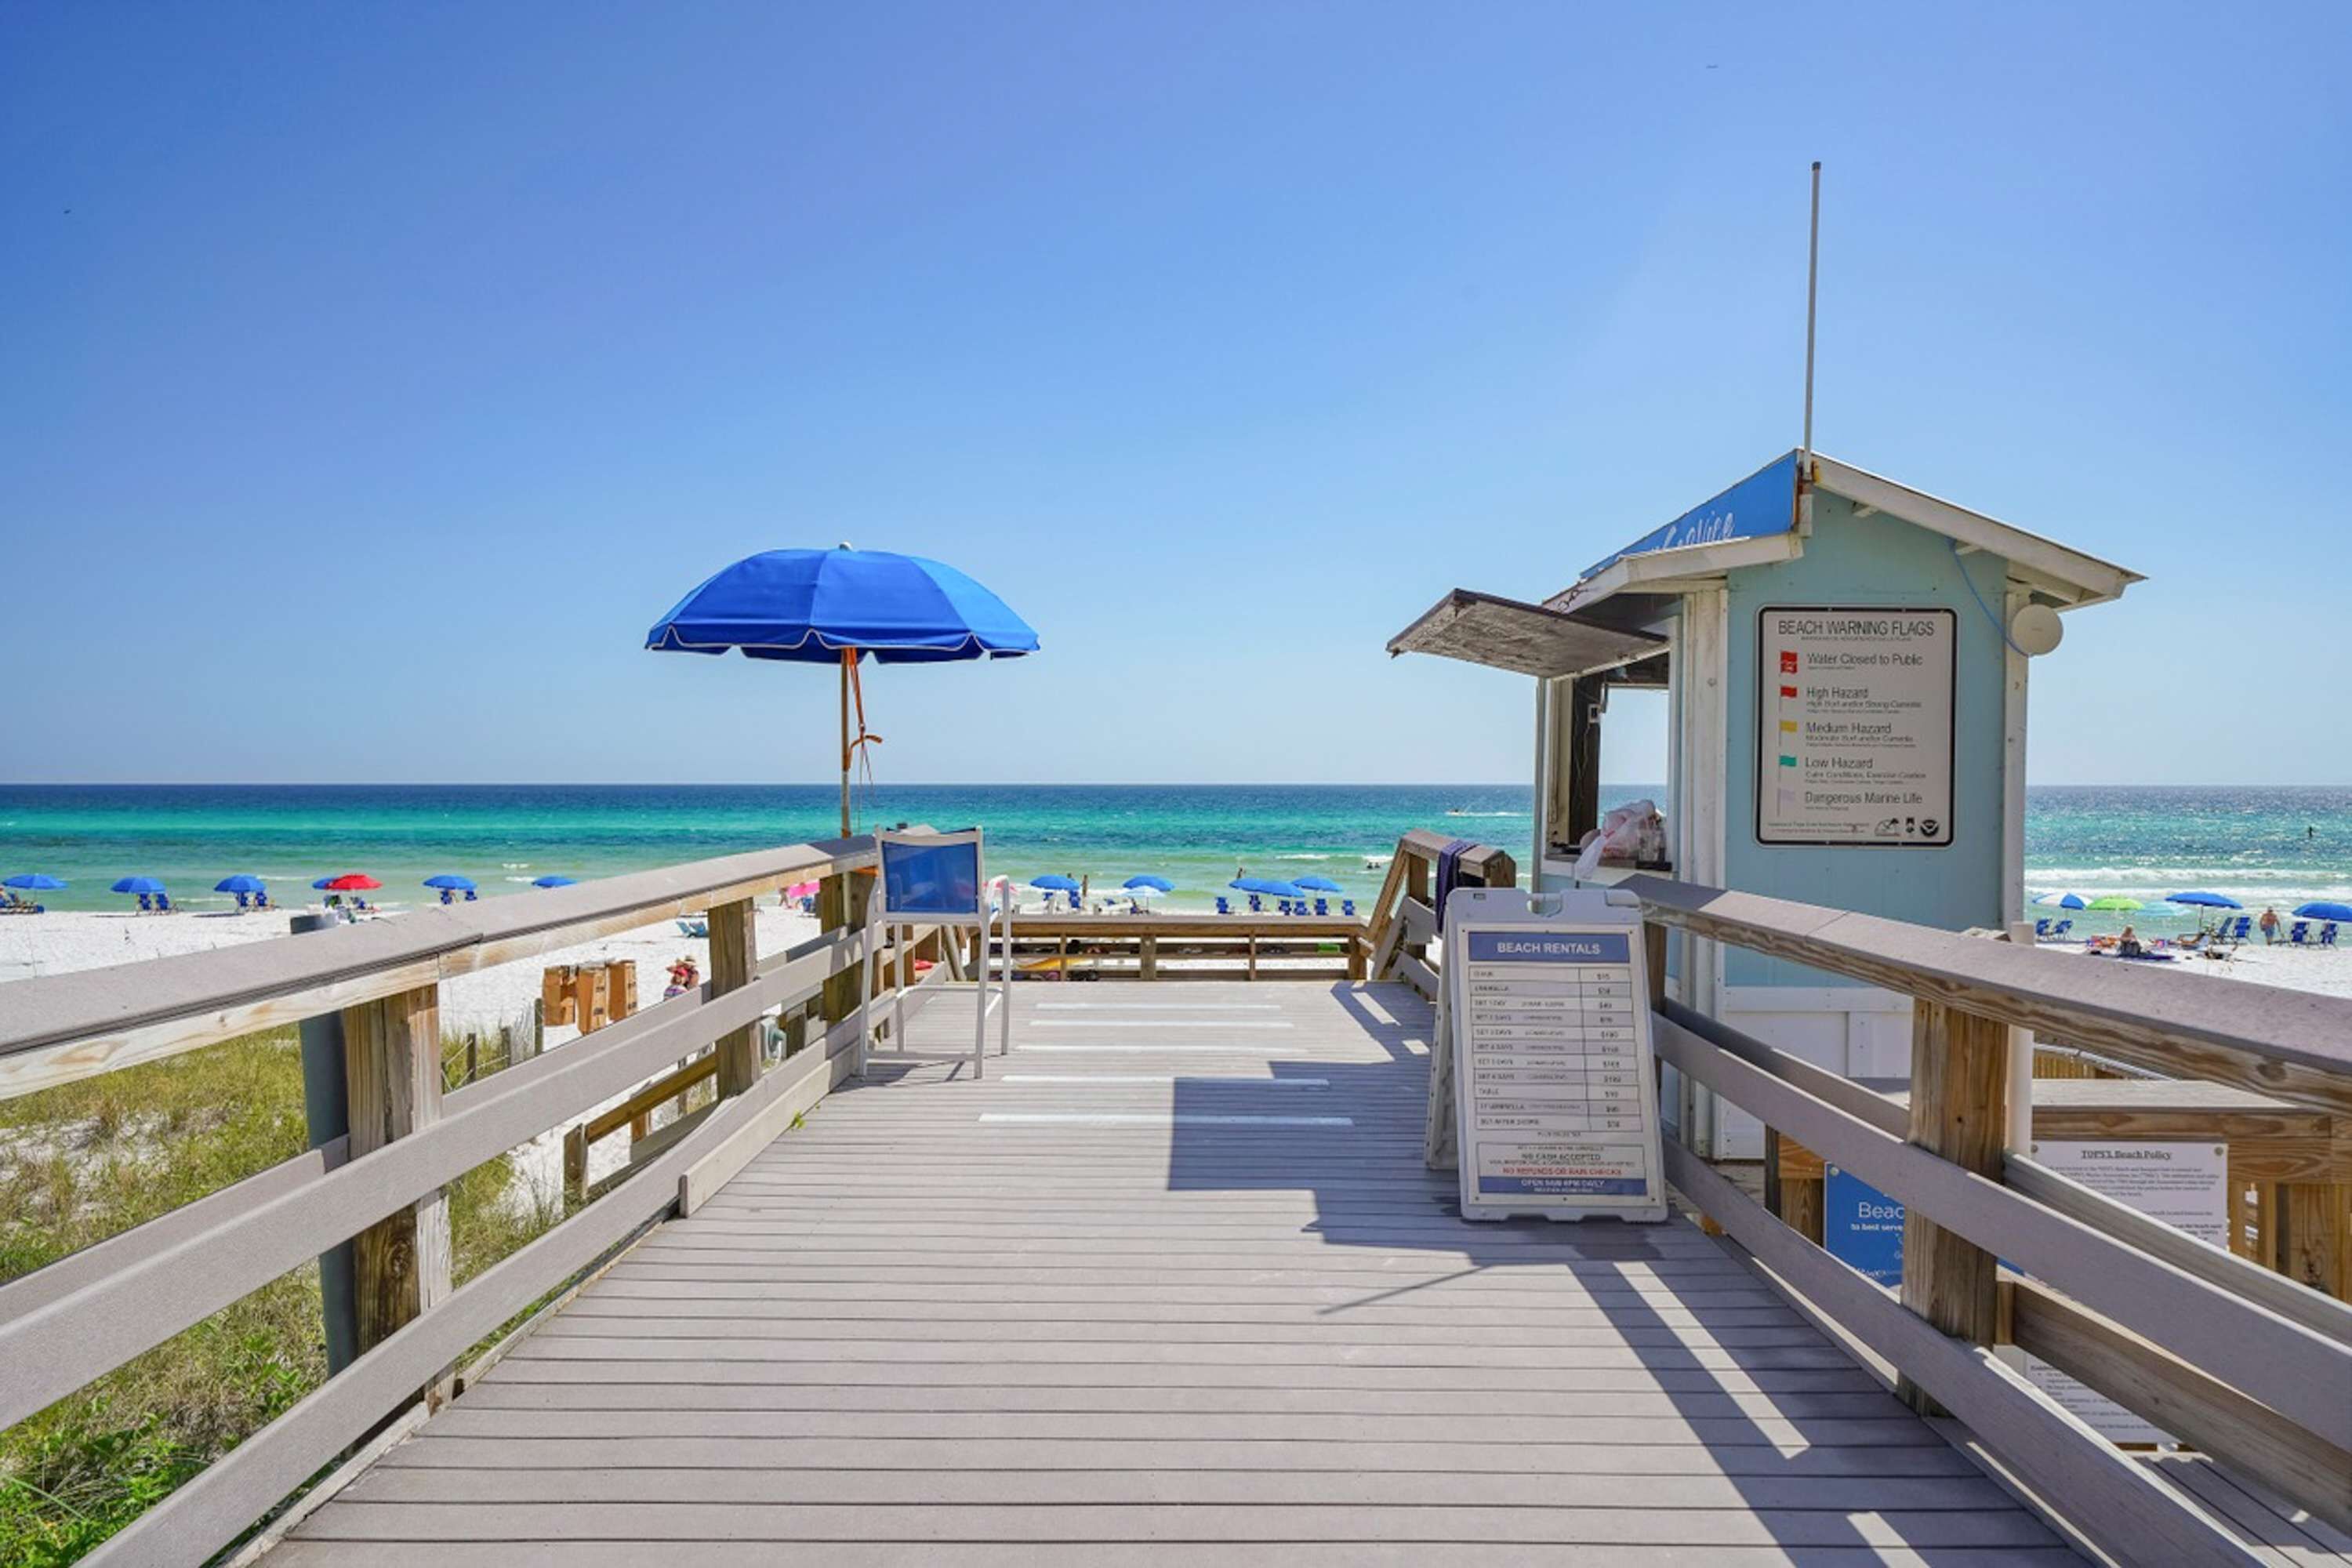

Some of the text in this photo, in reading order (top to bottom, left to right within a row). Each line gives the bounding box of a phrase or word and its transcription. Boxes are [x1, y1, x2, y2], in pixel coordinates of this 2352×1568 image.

[1778, 620, 1935, 637] BEACH WARNING FLAGS
[1807, 653, 1923, 666] Water Closed to Public
[1806, 687, 1868, 700] High Hazard
[1806, 722, 1892, 734] Medium Hazard
[1805, 757, 1874, 768] Low Hazard
[1805, 791, 1923, 805] Dangerous Marine Life
[1497, 942, 1601, 955] BEACH RENTALS
[2114, 1150, 2143, 1160] Beach
[2143, 1150, 2172, 1160] Policy
[1858, 1201, 1905, 1220] Beac
